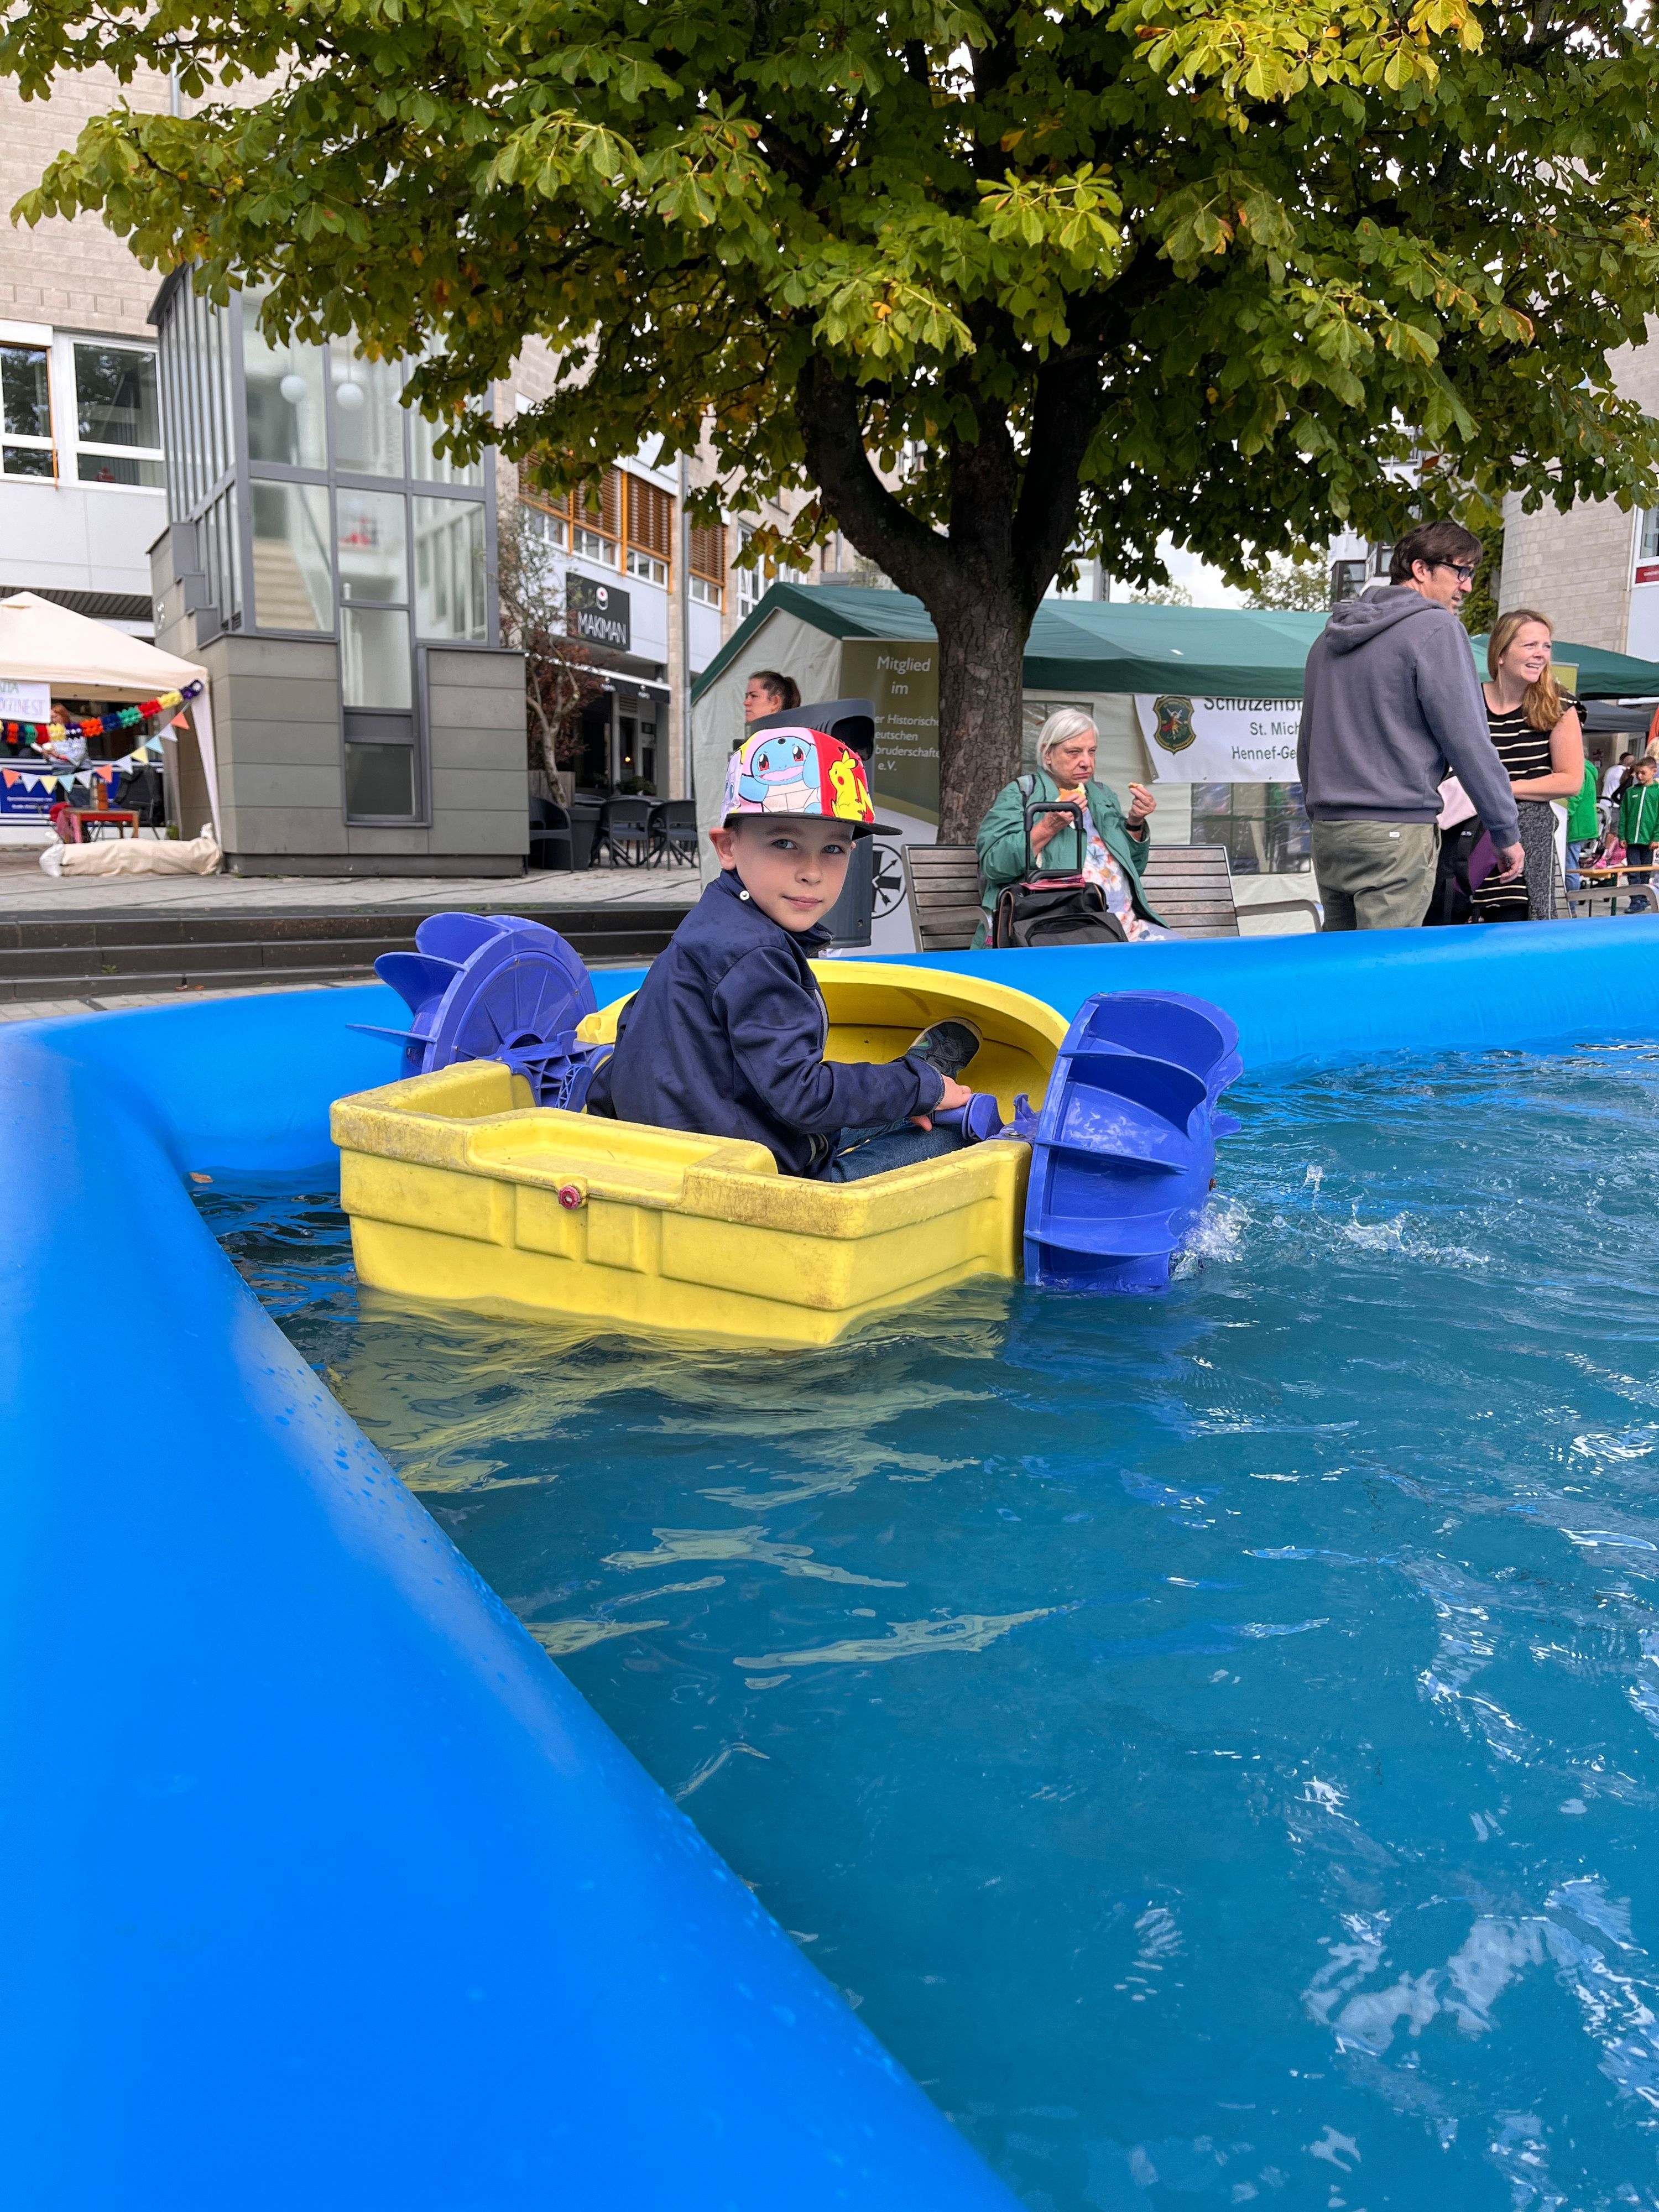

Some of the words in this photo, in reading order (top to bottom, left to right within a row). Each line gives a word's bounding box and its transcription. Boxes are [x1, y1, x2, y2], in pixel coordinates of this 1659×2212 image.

[577, 611, 627, 645] MAKIMAN
[877, 655, 931, 675] Mitglied
[891, 681, 909, 695] im
[1250, 722, 1267, 735] St.
[875, 731, 919, 741] eutschen
[1232, 745, 1296, 760] Hennef-Ge
[878, 760, 897, 771] e.V.
